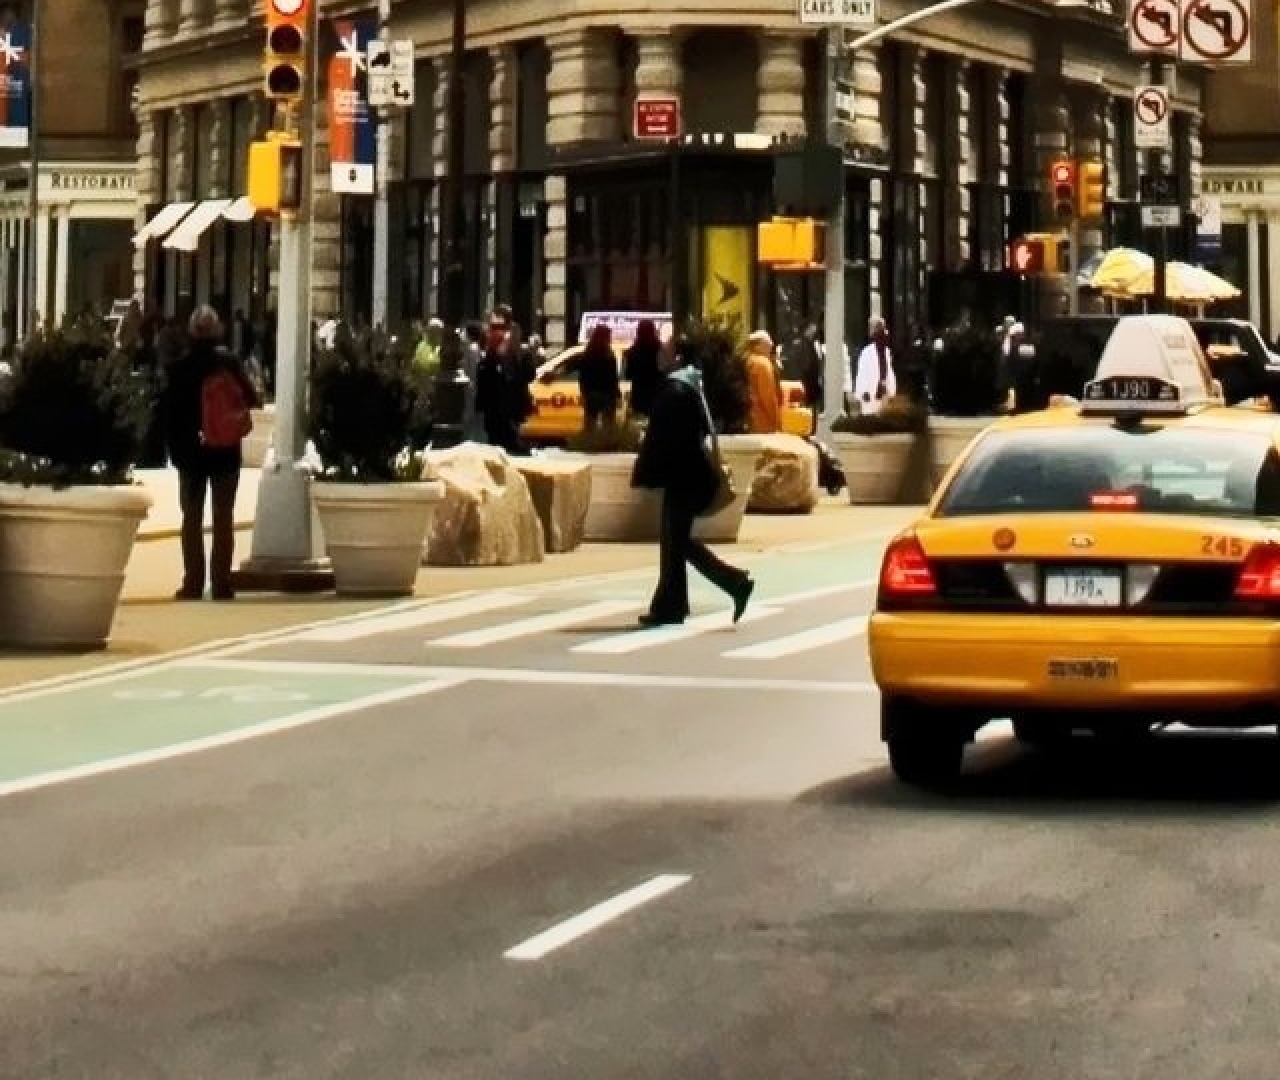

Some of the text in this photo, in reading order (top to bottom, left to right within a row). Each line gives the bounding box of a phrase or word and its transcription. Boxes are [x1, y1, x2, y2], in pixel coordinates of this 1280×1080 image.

[804, 0, 871, 15] CARS ONLY
[1201, 534, 1243, 557] 245
